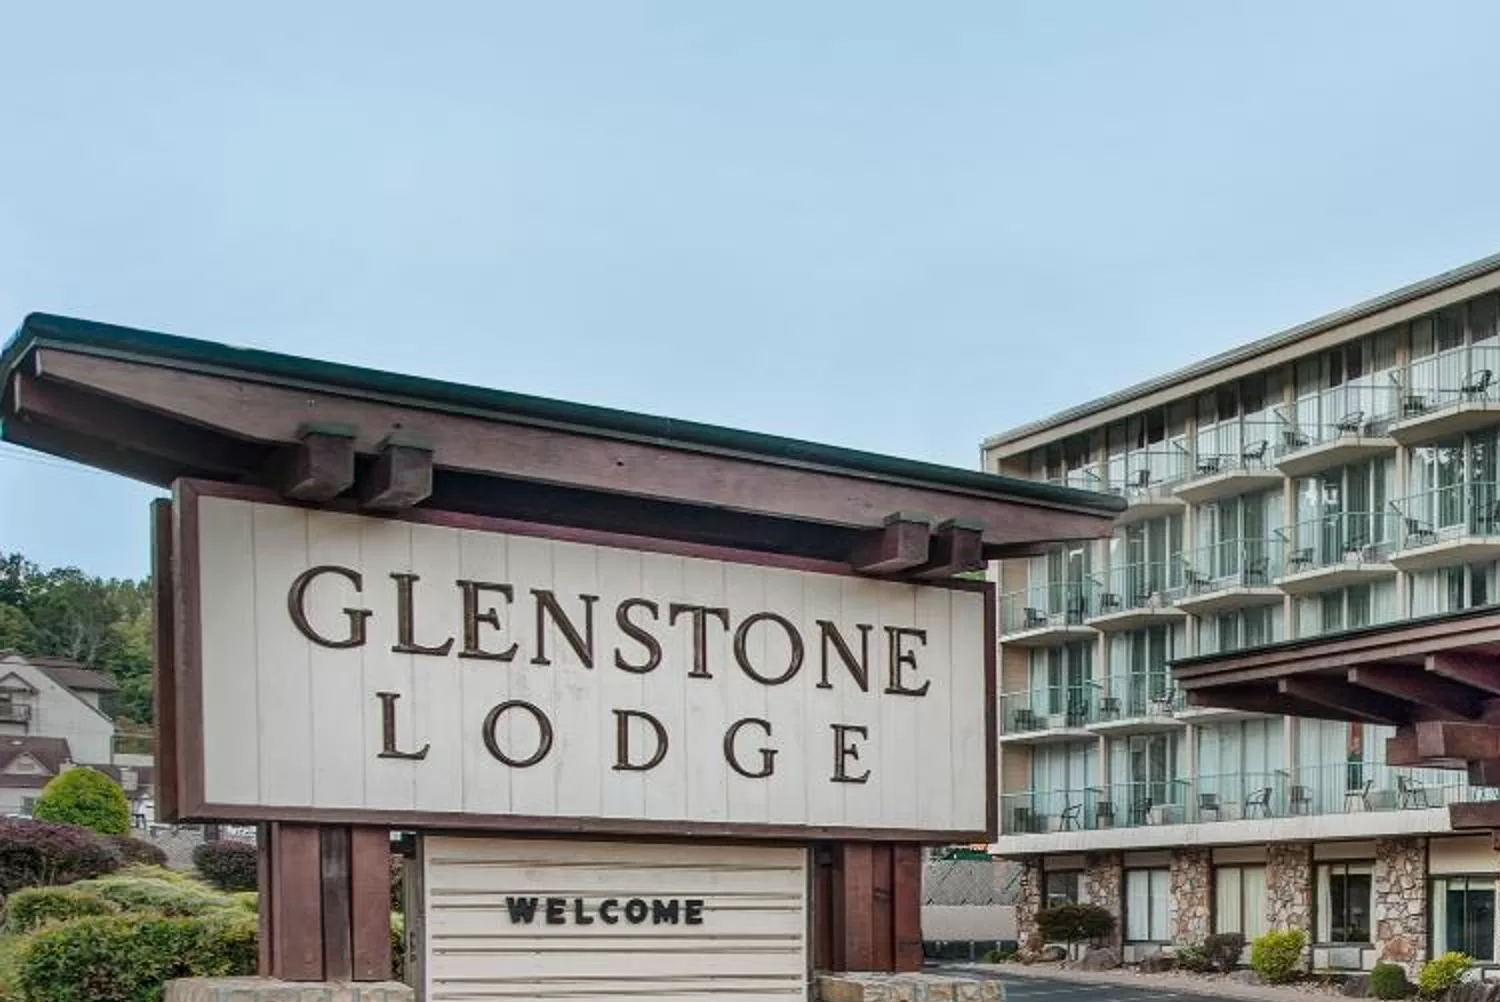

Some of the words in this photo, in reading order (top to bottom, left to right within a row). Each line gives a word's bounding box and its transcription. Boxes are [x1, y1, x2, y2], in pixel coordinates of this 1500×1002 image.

[287, 565, 932, 697] GLENSTONE
[376, 691, 872, 784] LODGE
[506, 896, 705, 926] WELCOME
